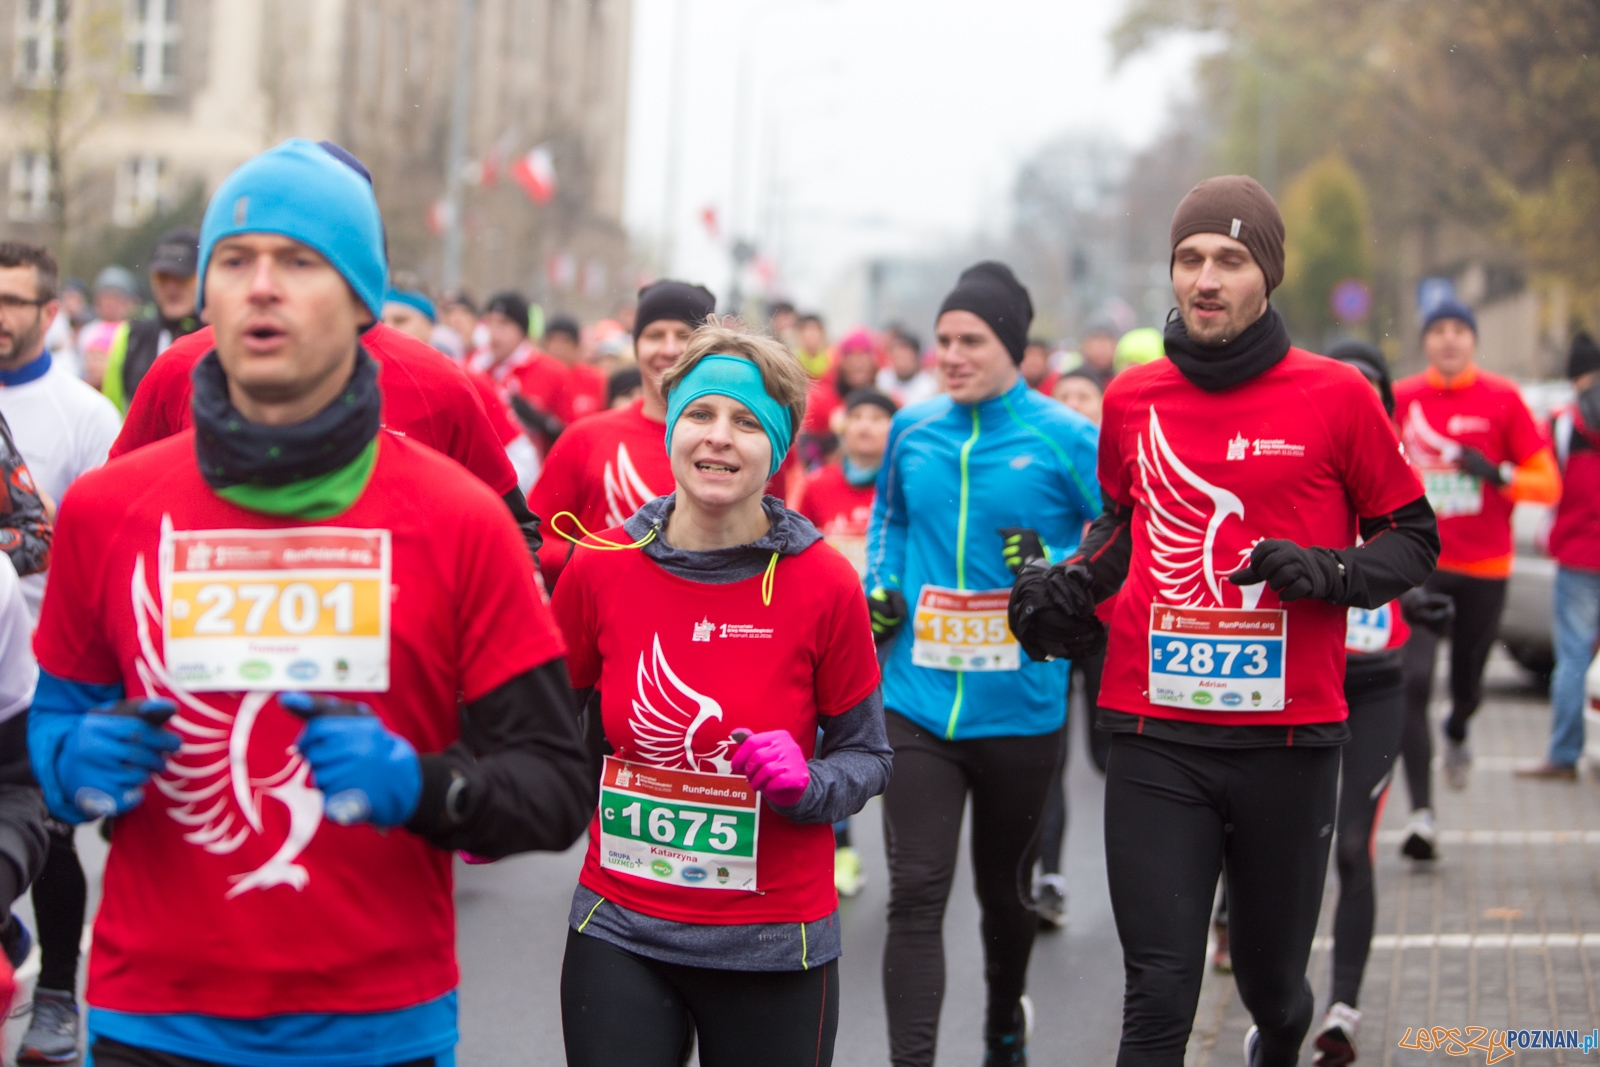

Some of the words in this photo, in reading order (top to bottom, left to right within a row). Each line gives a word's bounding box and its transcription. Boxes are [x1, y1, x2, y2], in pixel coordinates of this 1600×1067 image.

[193, 581, 354, 634] 2701
[719, 623, 728, 638] 1
[927, 615, 1007, 643] 1335
[1218, 620, 1275, 631] RunPoland.org
[1153, 648, 1162, 660] E
[1165, 640, 1269, 676] 2873
[1198, 680, 1227, 689] Adrian
[682, 784, 747, 800] RunPoland.org
[621, 801, 738, 851] 1675
[608, 850, 631, 861] GRUPA
[650, 846, 698, 863] Katarzyna
[608, 857, 635, 869] LUXMED
